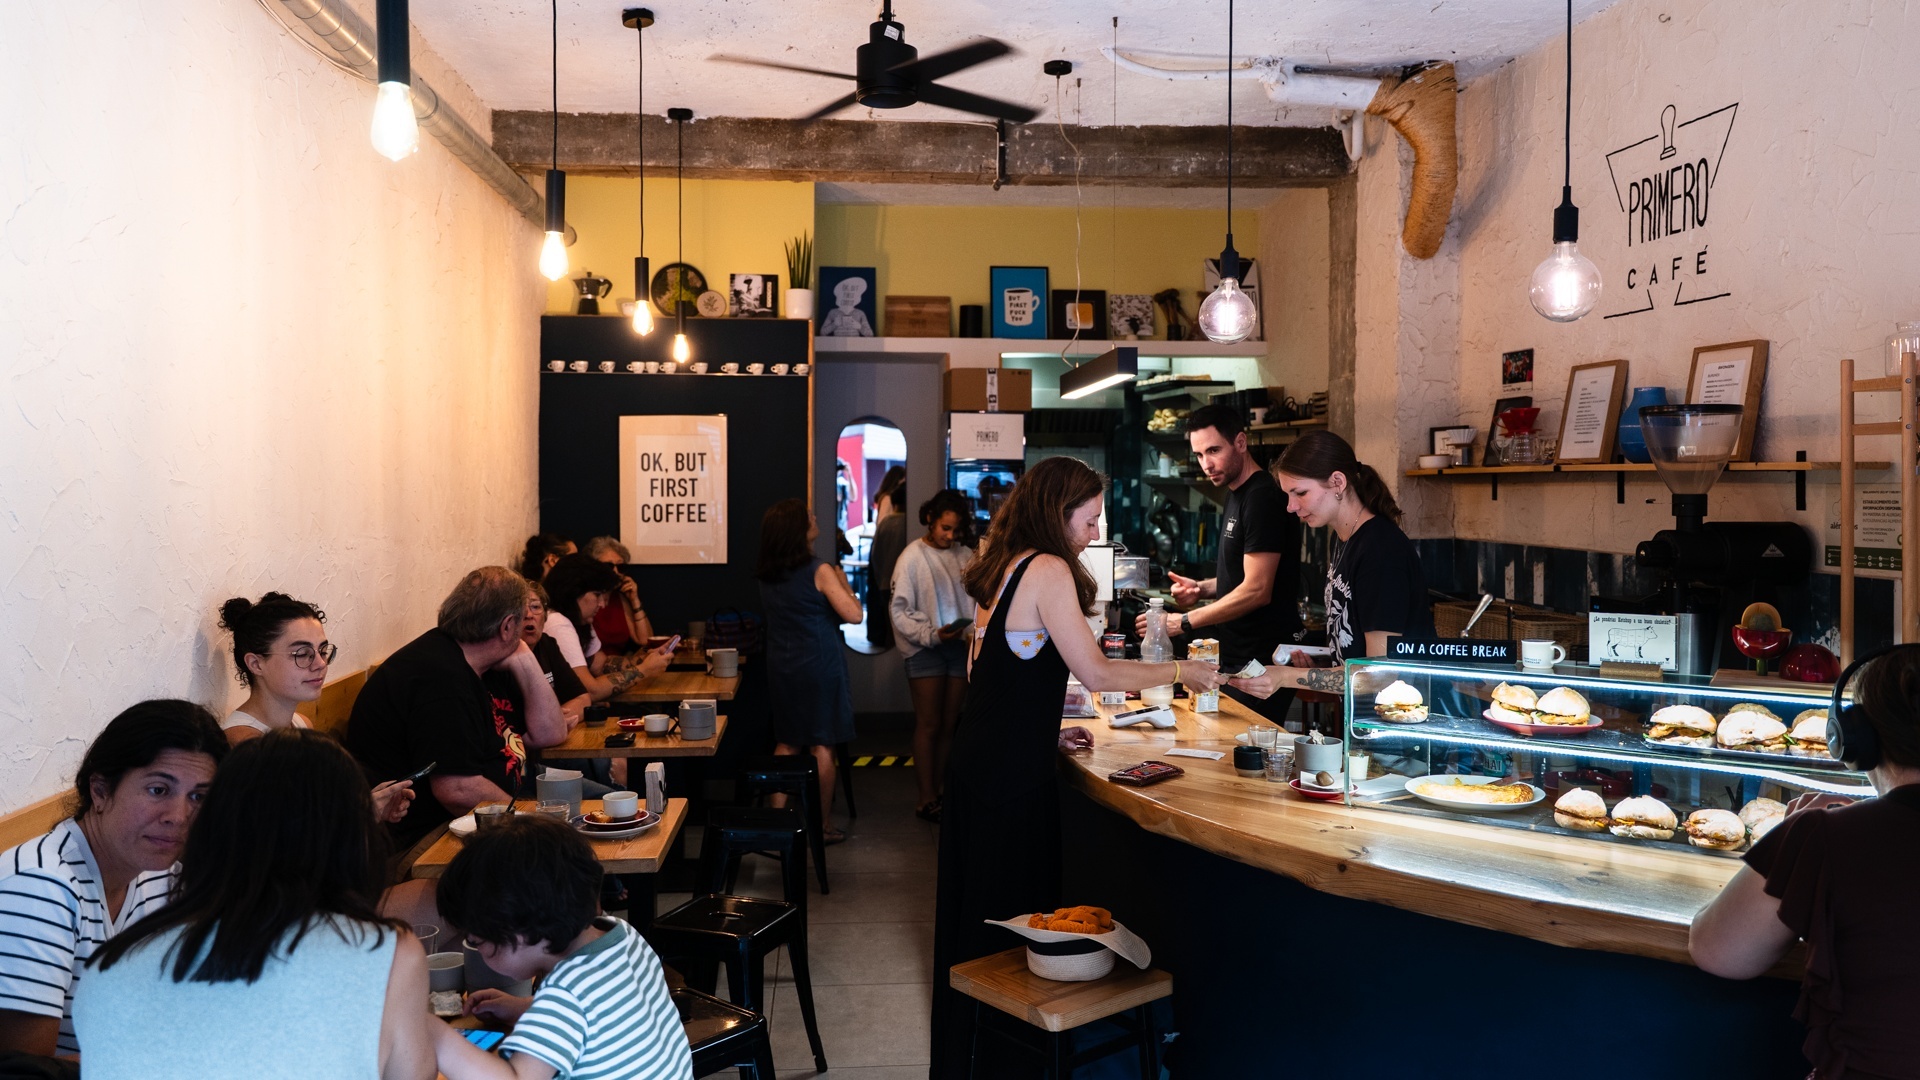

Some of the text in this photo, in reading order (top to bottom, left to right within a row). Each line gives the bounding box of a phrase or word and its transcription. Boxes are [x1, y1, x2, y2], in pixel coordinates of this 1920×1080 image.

[1628, 157, 1709, 247] PRIMERO
[1627, 244, 1708, 289] CAFÉ
[976, 431, 999, 442] PRIMERO
[640, 452, 707, 473] OK, BUT
[650, 478, 698, 497] FIRST
[641, 503, 707, 523] COFFEE
[1396, 642, 1507, 657] ON A COFFEE BREAK
